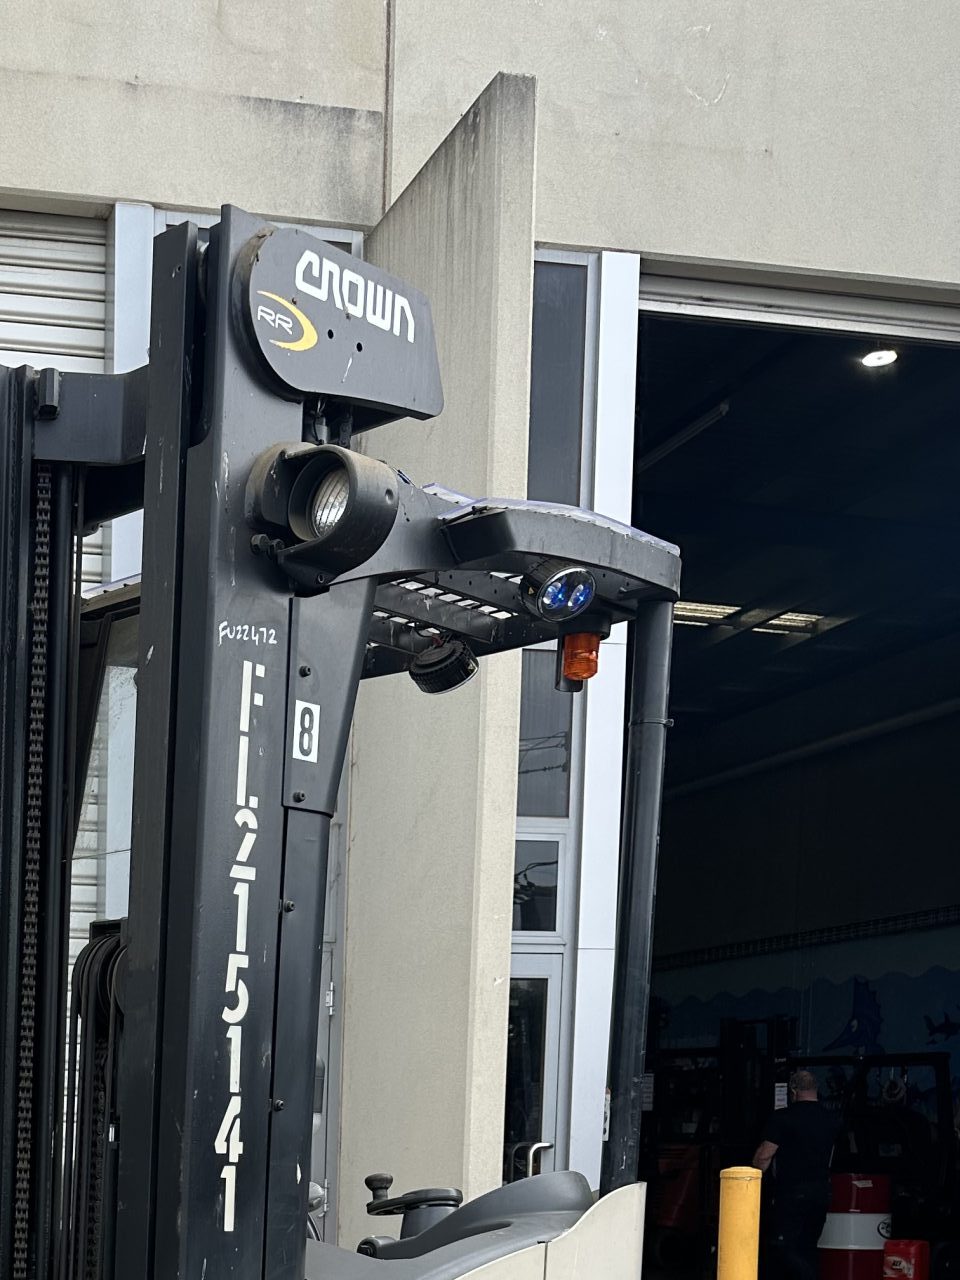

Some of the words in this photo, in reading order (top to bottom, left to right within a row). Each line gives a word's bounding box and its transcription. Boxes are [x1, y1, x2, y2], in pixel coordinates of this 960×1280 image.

[295, 249, 415, 344] CROWN
[257, 305, 293, 335] RR
[218, 620, 278, 646] FU22472
[298, 706, 315, 757] 8
